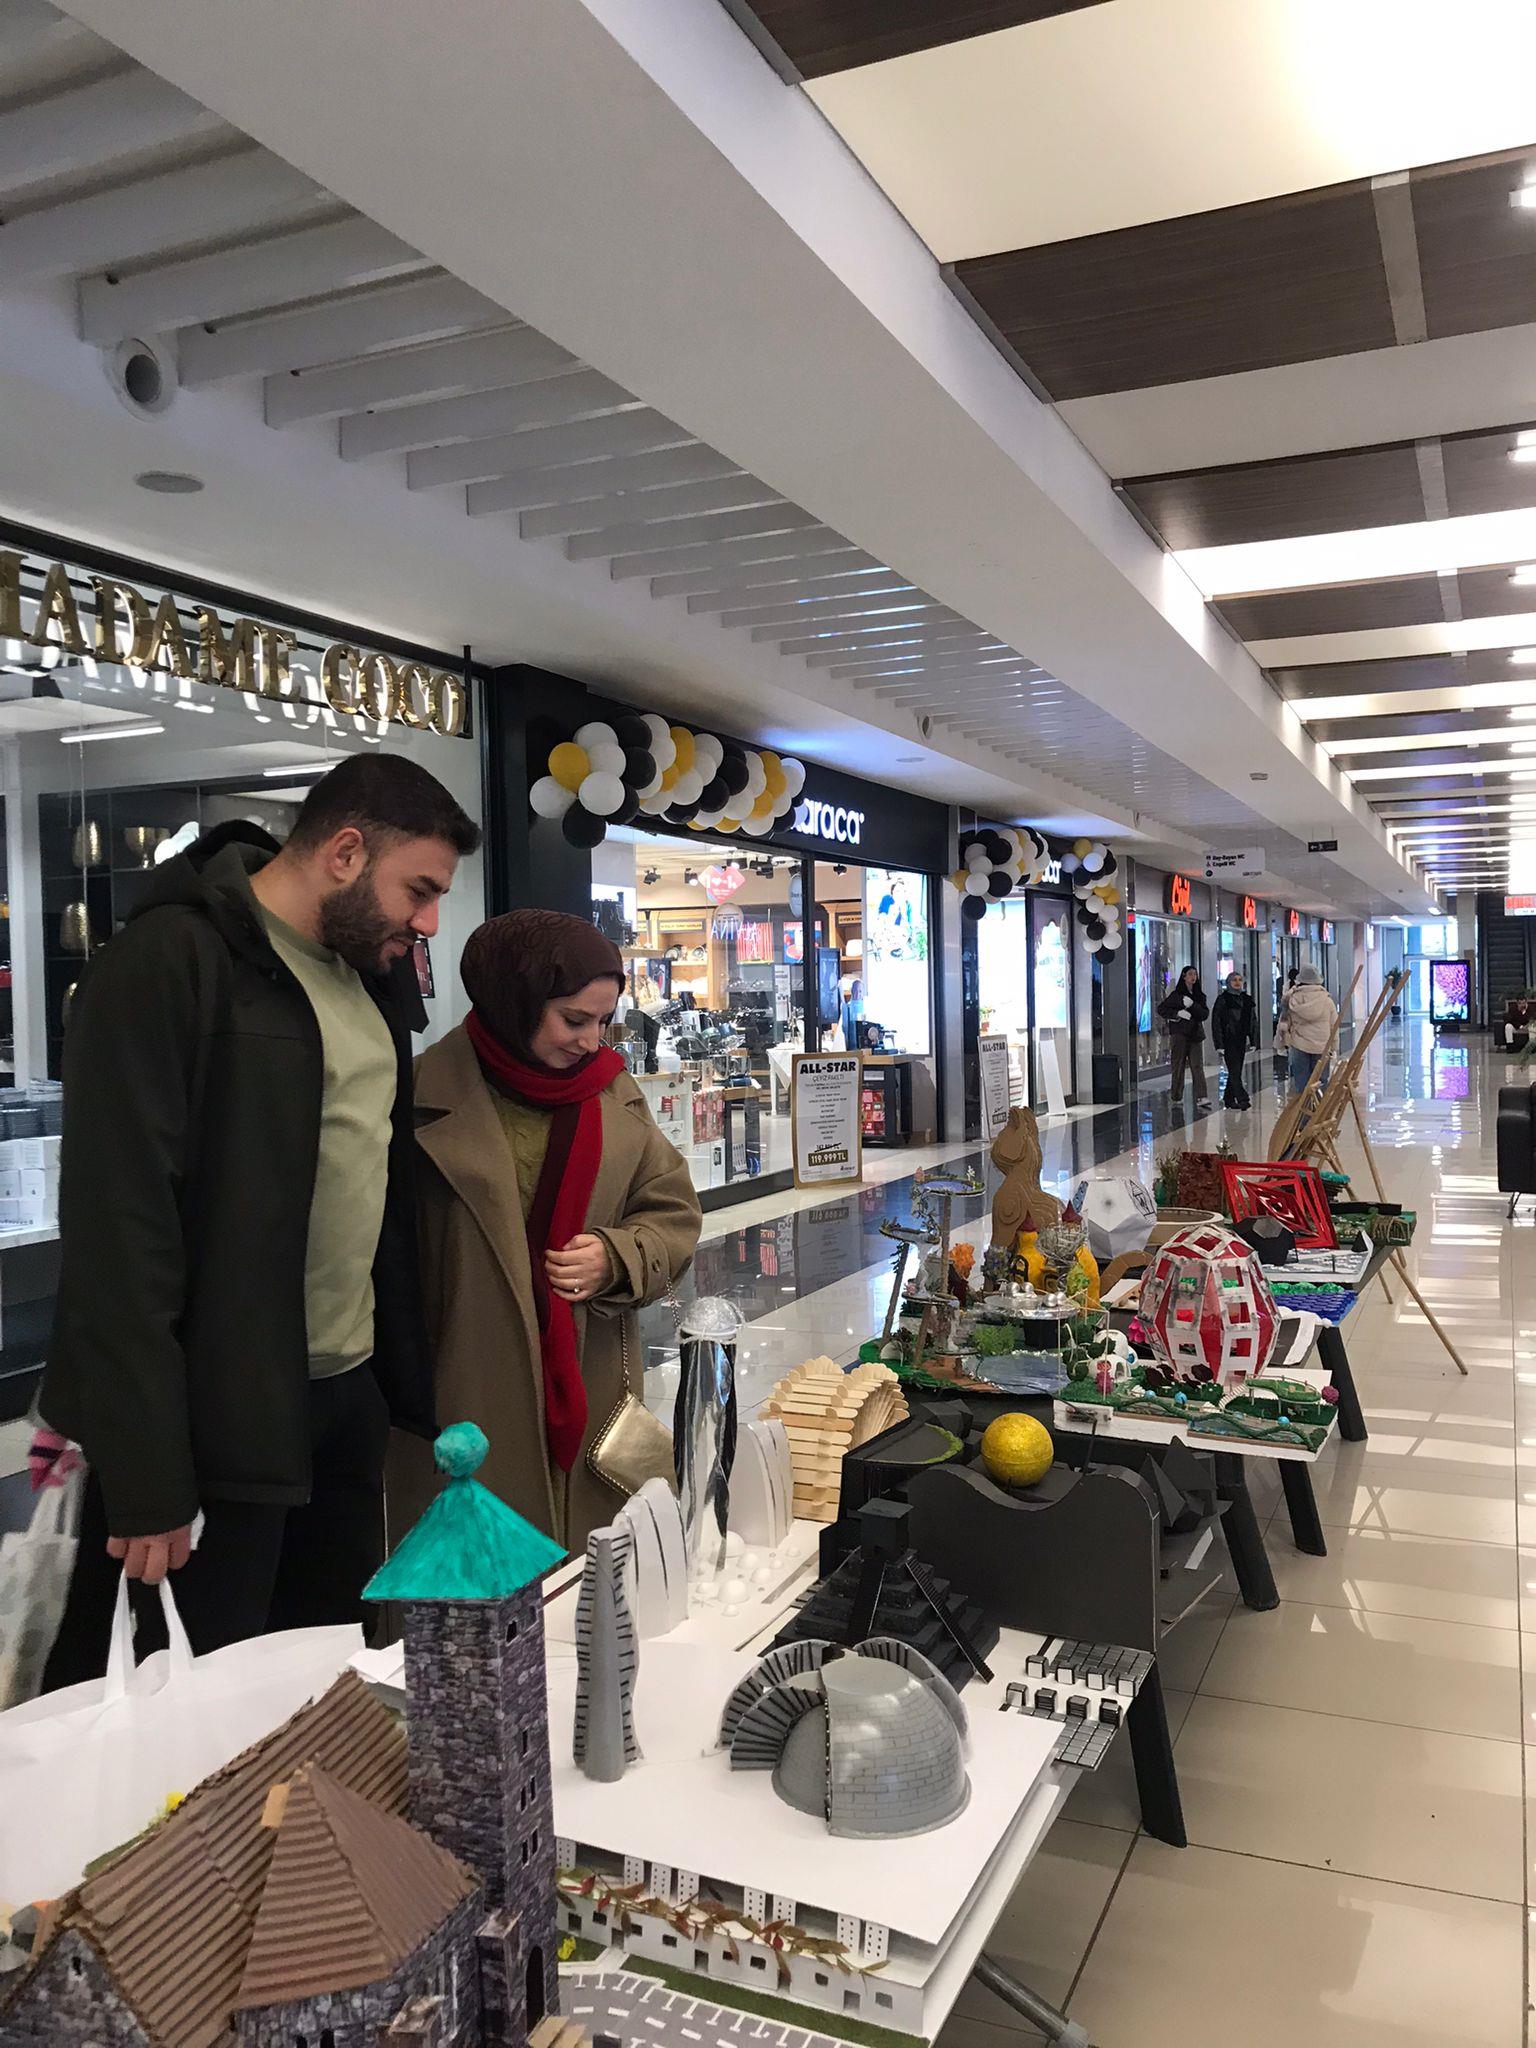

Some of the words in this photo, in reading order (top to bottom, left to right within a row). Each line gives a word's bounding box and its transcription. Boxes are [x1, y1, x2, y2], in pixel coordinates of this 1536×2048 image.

[320, 643, 466, 736] COCO
[790, 797, 861, 845] araca
[800, 1061, 857, 1075] ALL-STAR
[811, 1152, 837, 1164] 119.999
[837, 1152, 846, 1161] TL
